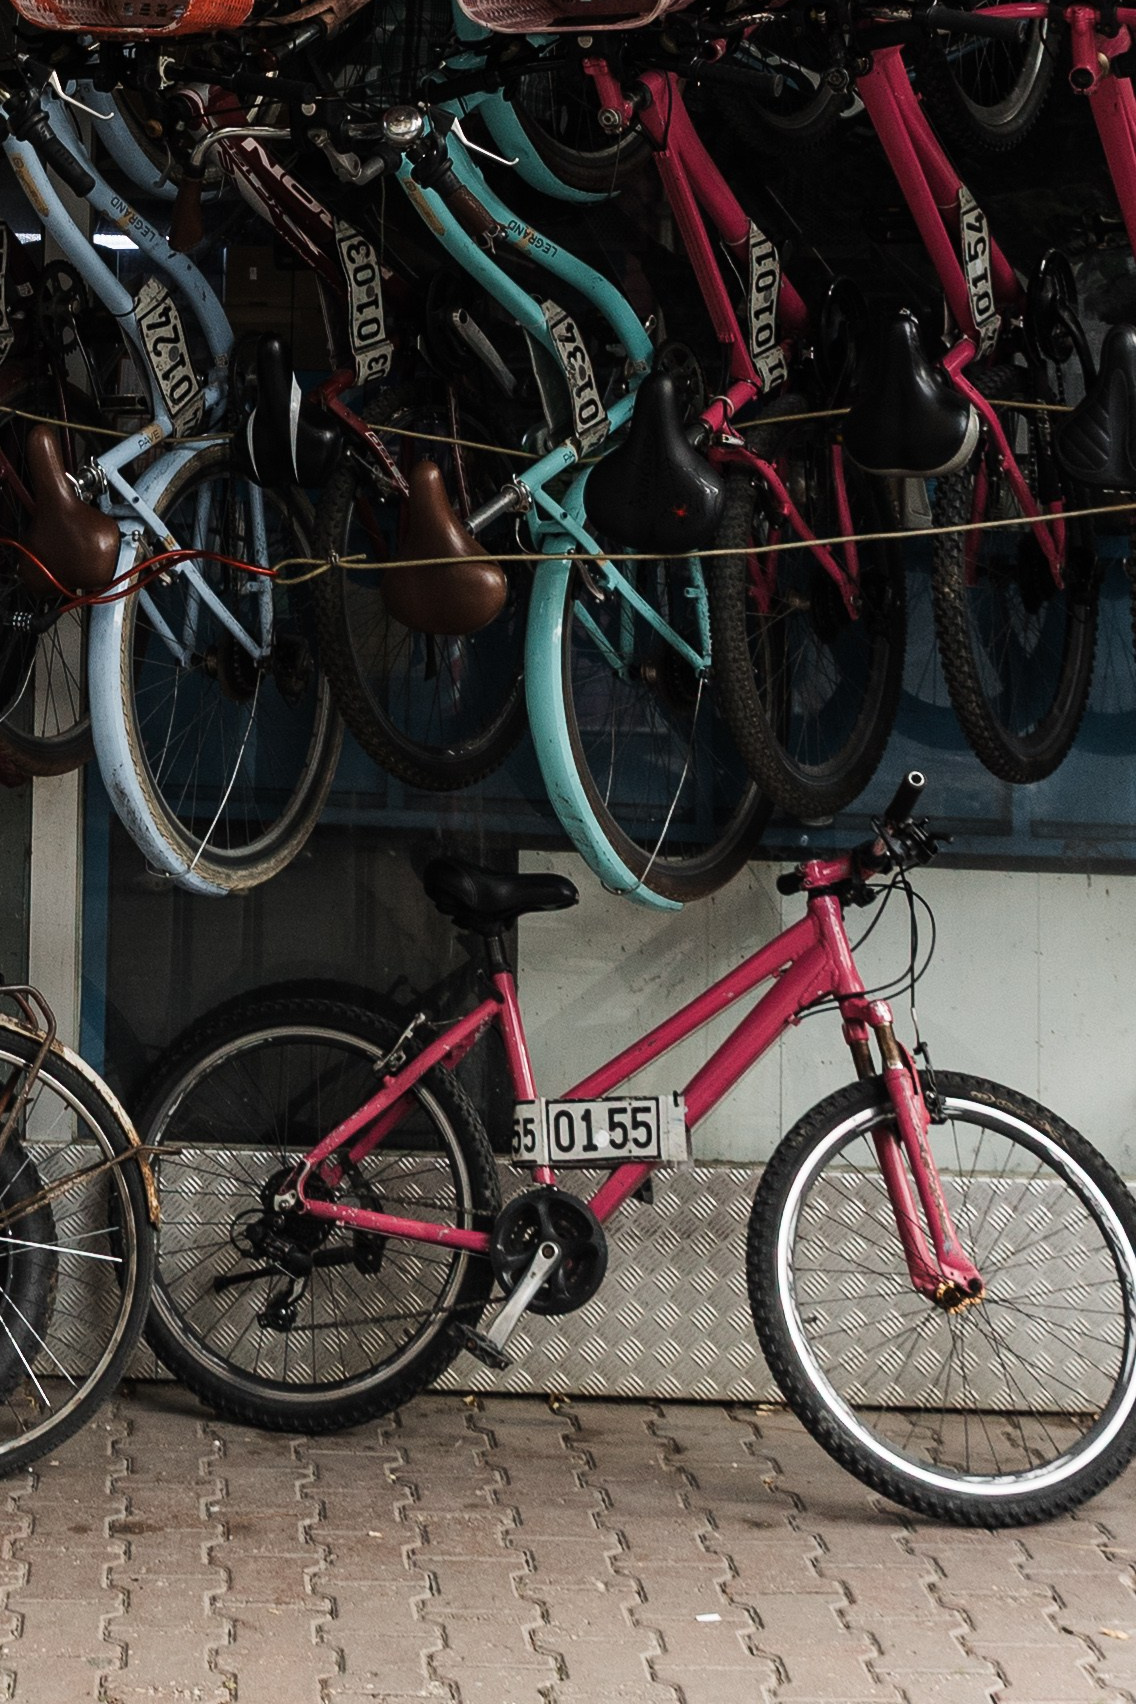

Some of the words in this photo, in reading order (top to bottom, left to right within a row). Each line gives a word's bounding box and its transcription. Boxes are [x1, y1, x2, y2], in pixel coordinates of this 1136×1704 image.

[110, 197, 156, 243] LEGRAND
[508, 219, 557, 258] LEGRAND
[965, 213, 992, 322] 0154
[346, 239, 382, 342] 0103
[753, 249, 778, 346] 0101
[146, 302, 193, 405] 0124
[557, 322, 599, 426] 0134
[137, 428, 161, 450] PAVE
[554, 1106, 653, 1153] 0155
